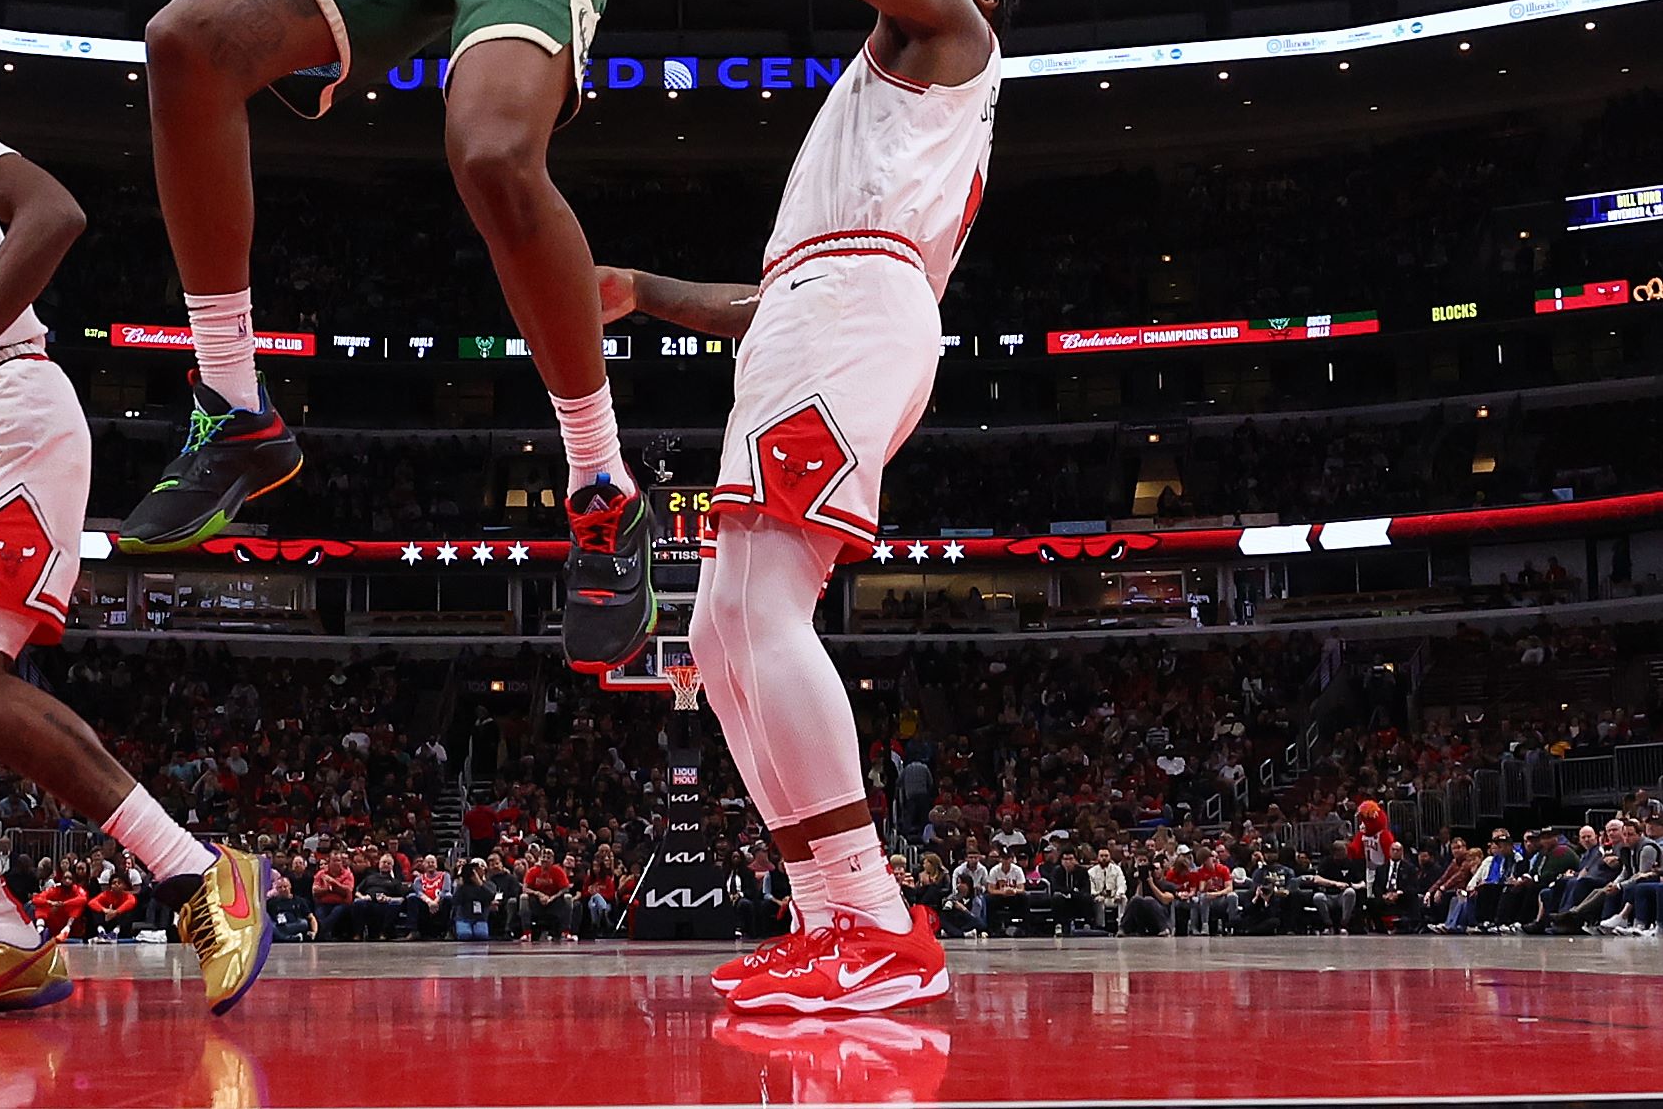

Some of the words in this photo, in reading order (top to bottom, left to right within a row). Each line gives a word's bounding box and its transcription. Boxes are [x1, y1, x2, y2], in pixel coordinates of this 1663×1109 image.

[1525, 1, 1555, 13] Illinois
[717, 57, 840, 88] CEN
[1617, 194, 1636, 208] BILL
[1638, 191, 1662, 206] BURR
[1432, 303, 1477, 322] BLOCKS
[1060, 331, 1138, 350] Budweiser
[1143, 328, 1206, 345] CHAMPIONS
[1210, 326, 1239, 341] CLUB
[1307, 325, 1330, 338] BULLS
[122, 327, 194, 344] Budweise
[274, 339, 302, 351] CLUB
[334, 336, 370, 347] TIMEOUTS
[409, 337, 433, 347] FOULS
[1000, 334, 1023, 346] FOULS
[661, 337, 698, 355] 2:16
[669, 492, 711, 512] 2:15
[673, 776, 698, 785] MOLY
[671, 793, 700, 802] KIA
[671, 822, 700, 832] KIA
[665, 852, 706, 863] KIA
[646, 888, 723, 908] KIA
